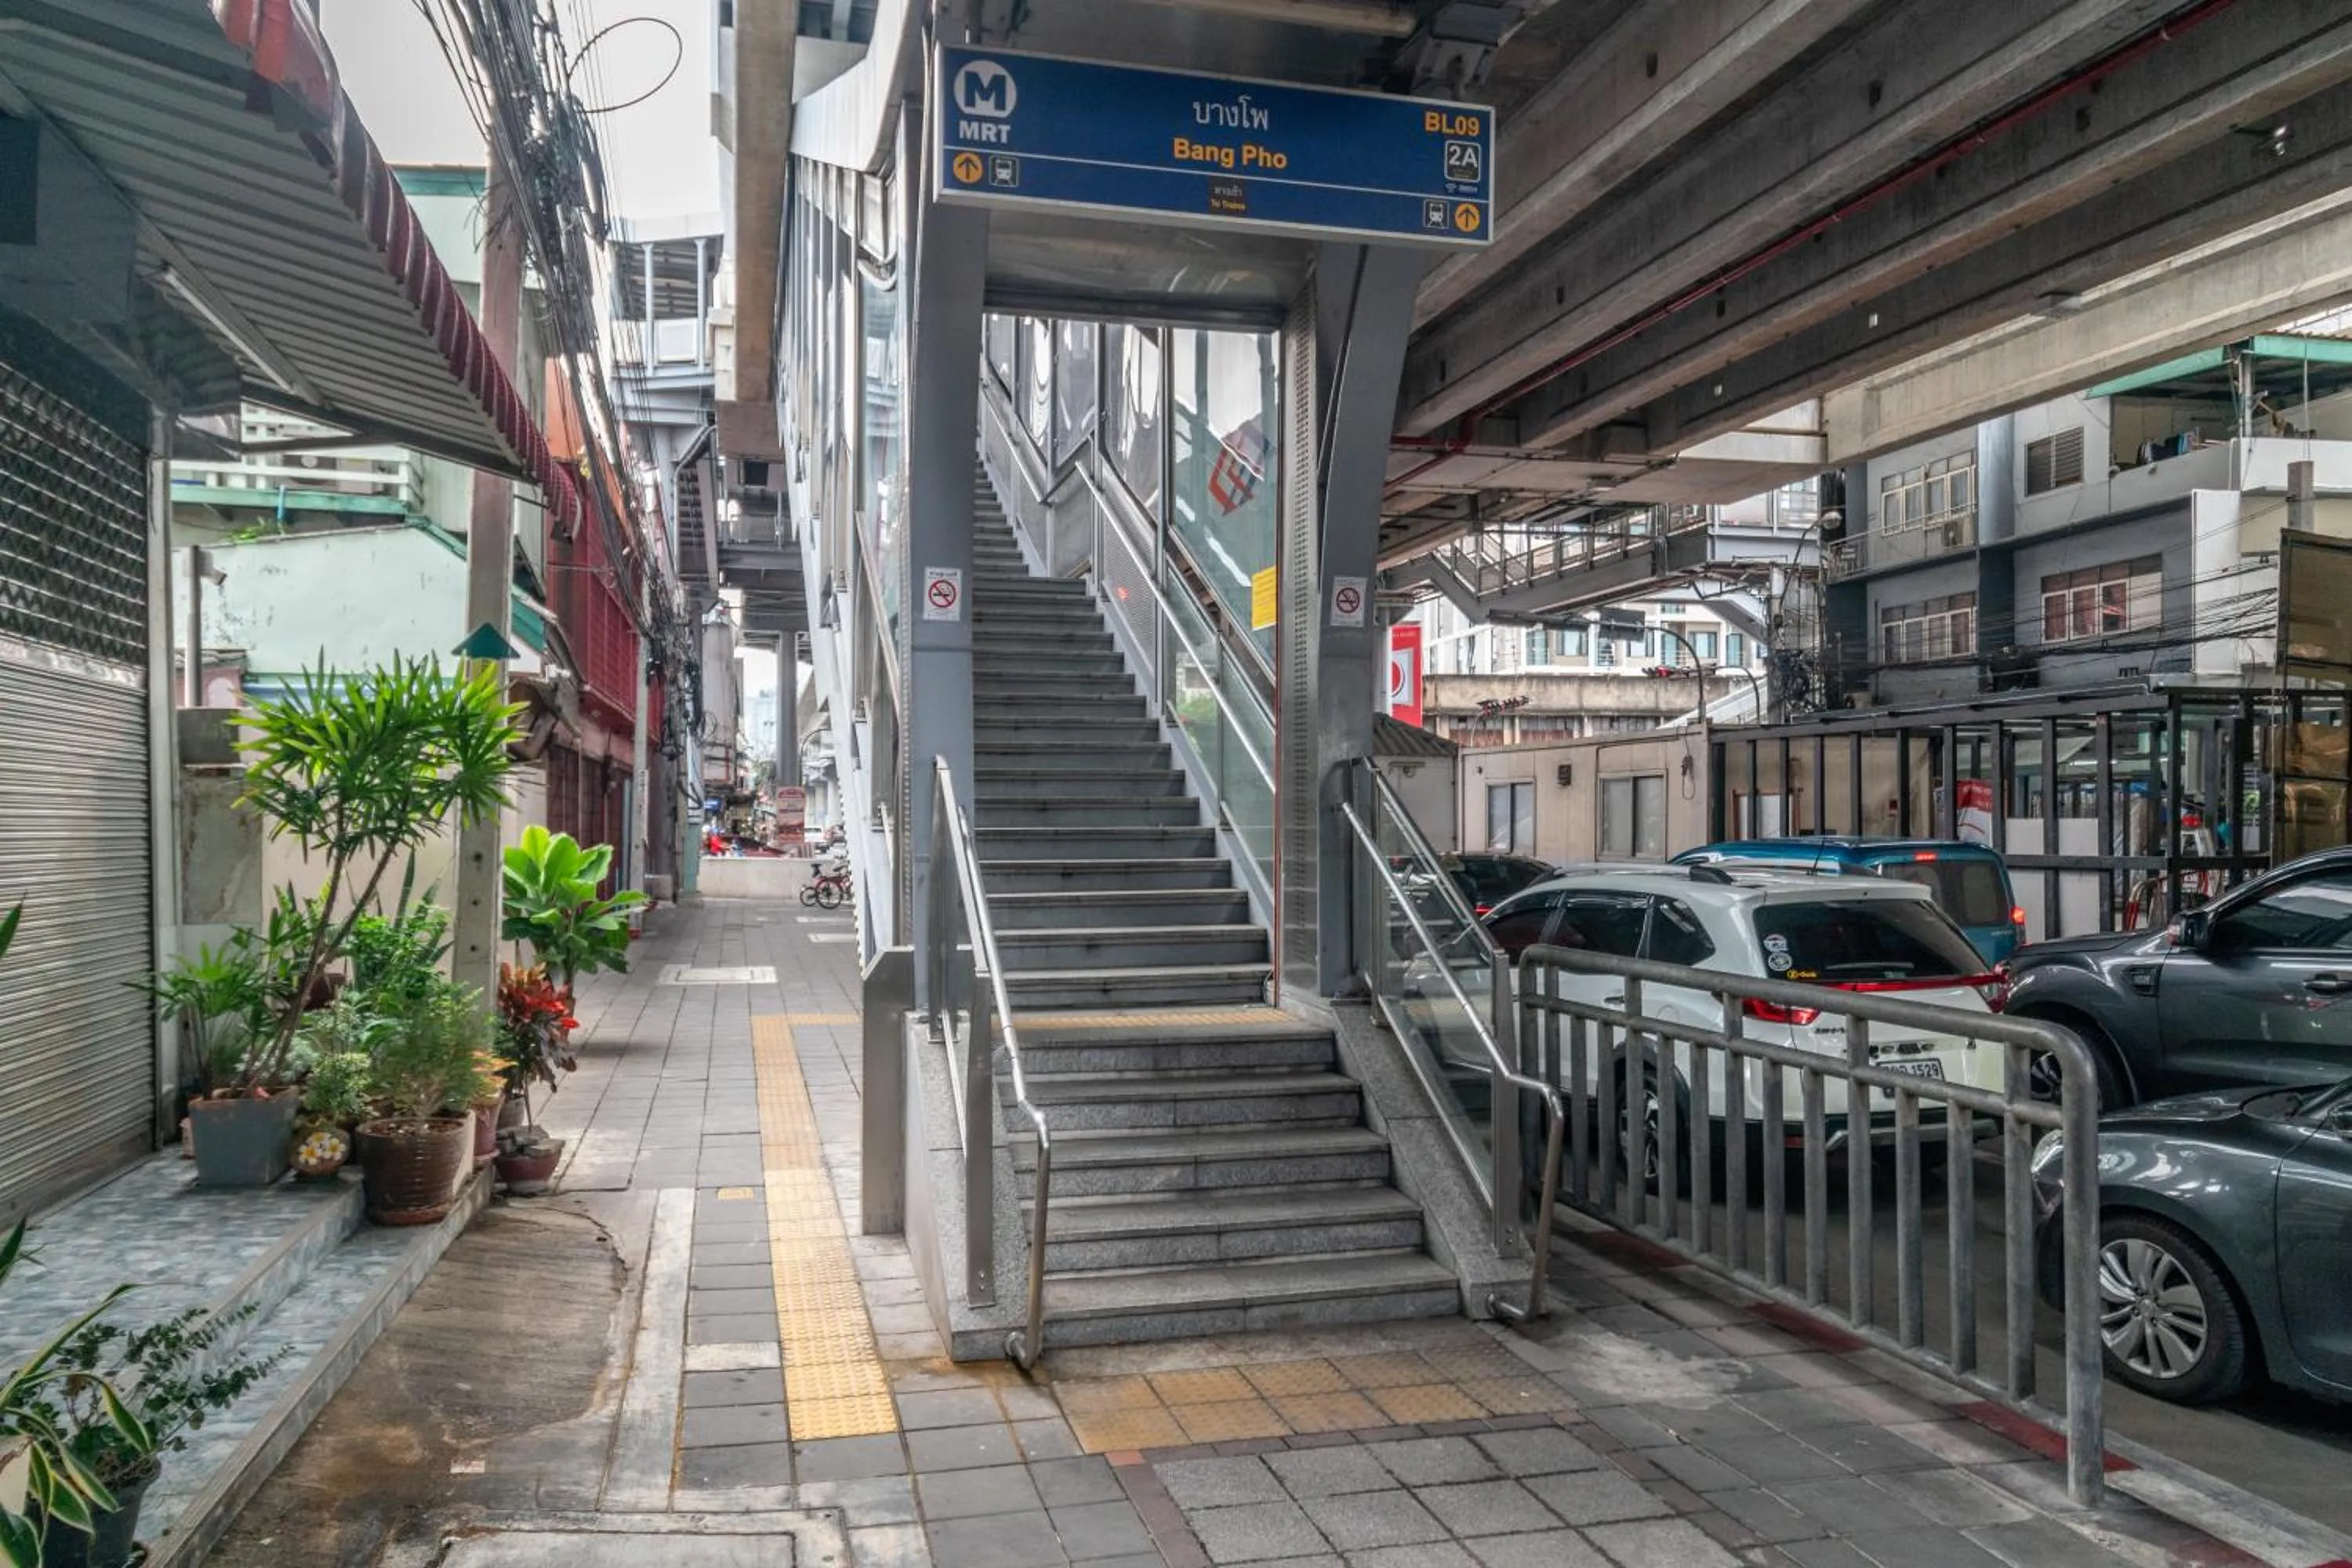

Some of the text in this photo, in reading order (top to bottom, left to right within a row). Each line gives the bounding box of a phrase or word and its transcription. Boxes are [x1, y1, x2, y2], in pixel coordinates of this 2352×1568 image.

[1192, 94, 1269, 132] บางโพ
[1424, 111, 1481, 137] BL09
[959, 120, 1012, 144] MRT
[1173, 136, 1288, 170] Bang Pho
[1449, 145, 1479, 168] 2A
